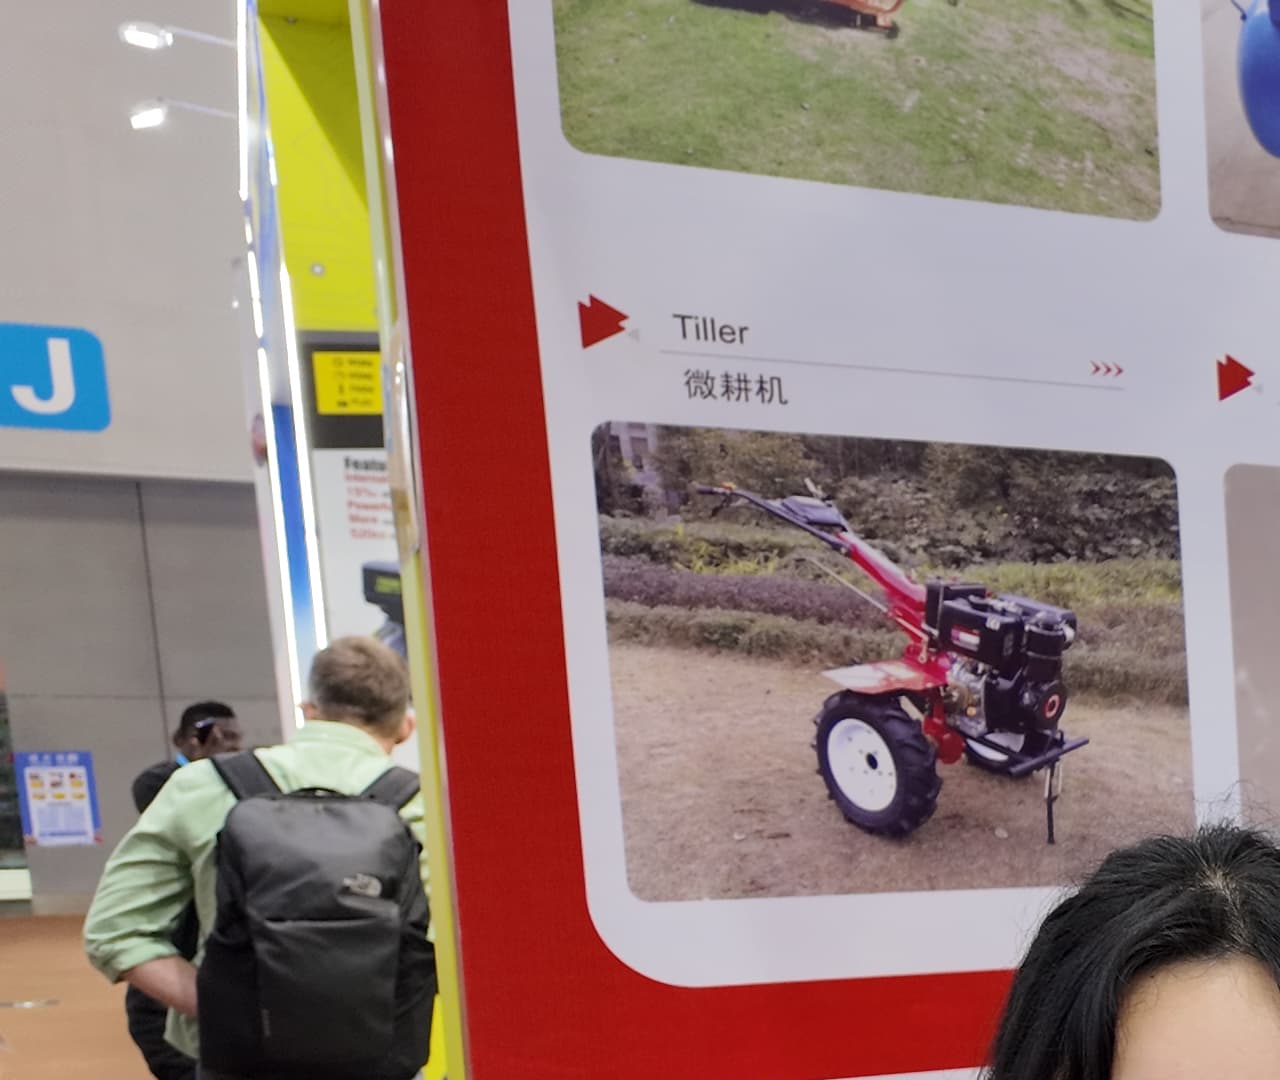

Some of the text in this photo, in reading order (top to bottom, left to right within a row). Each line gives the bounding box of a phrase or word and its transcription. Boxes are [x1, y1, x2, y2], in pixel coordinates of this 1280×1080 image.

[672, 314, 749, 345] Tiller
[9, 337, 76, 415] J
[684, 369, 789, 405] 微耕机
